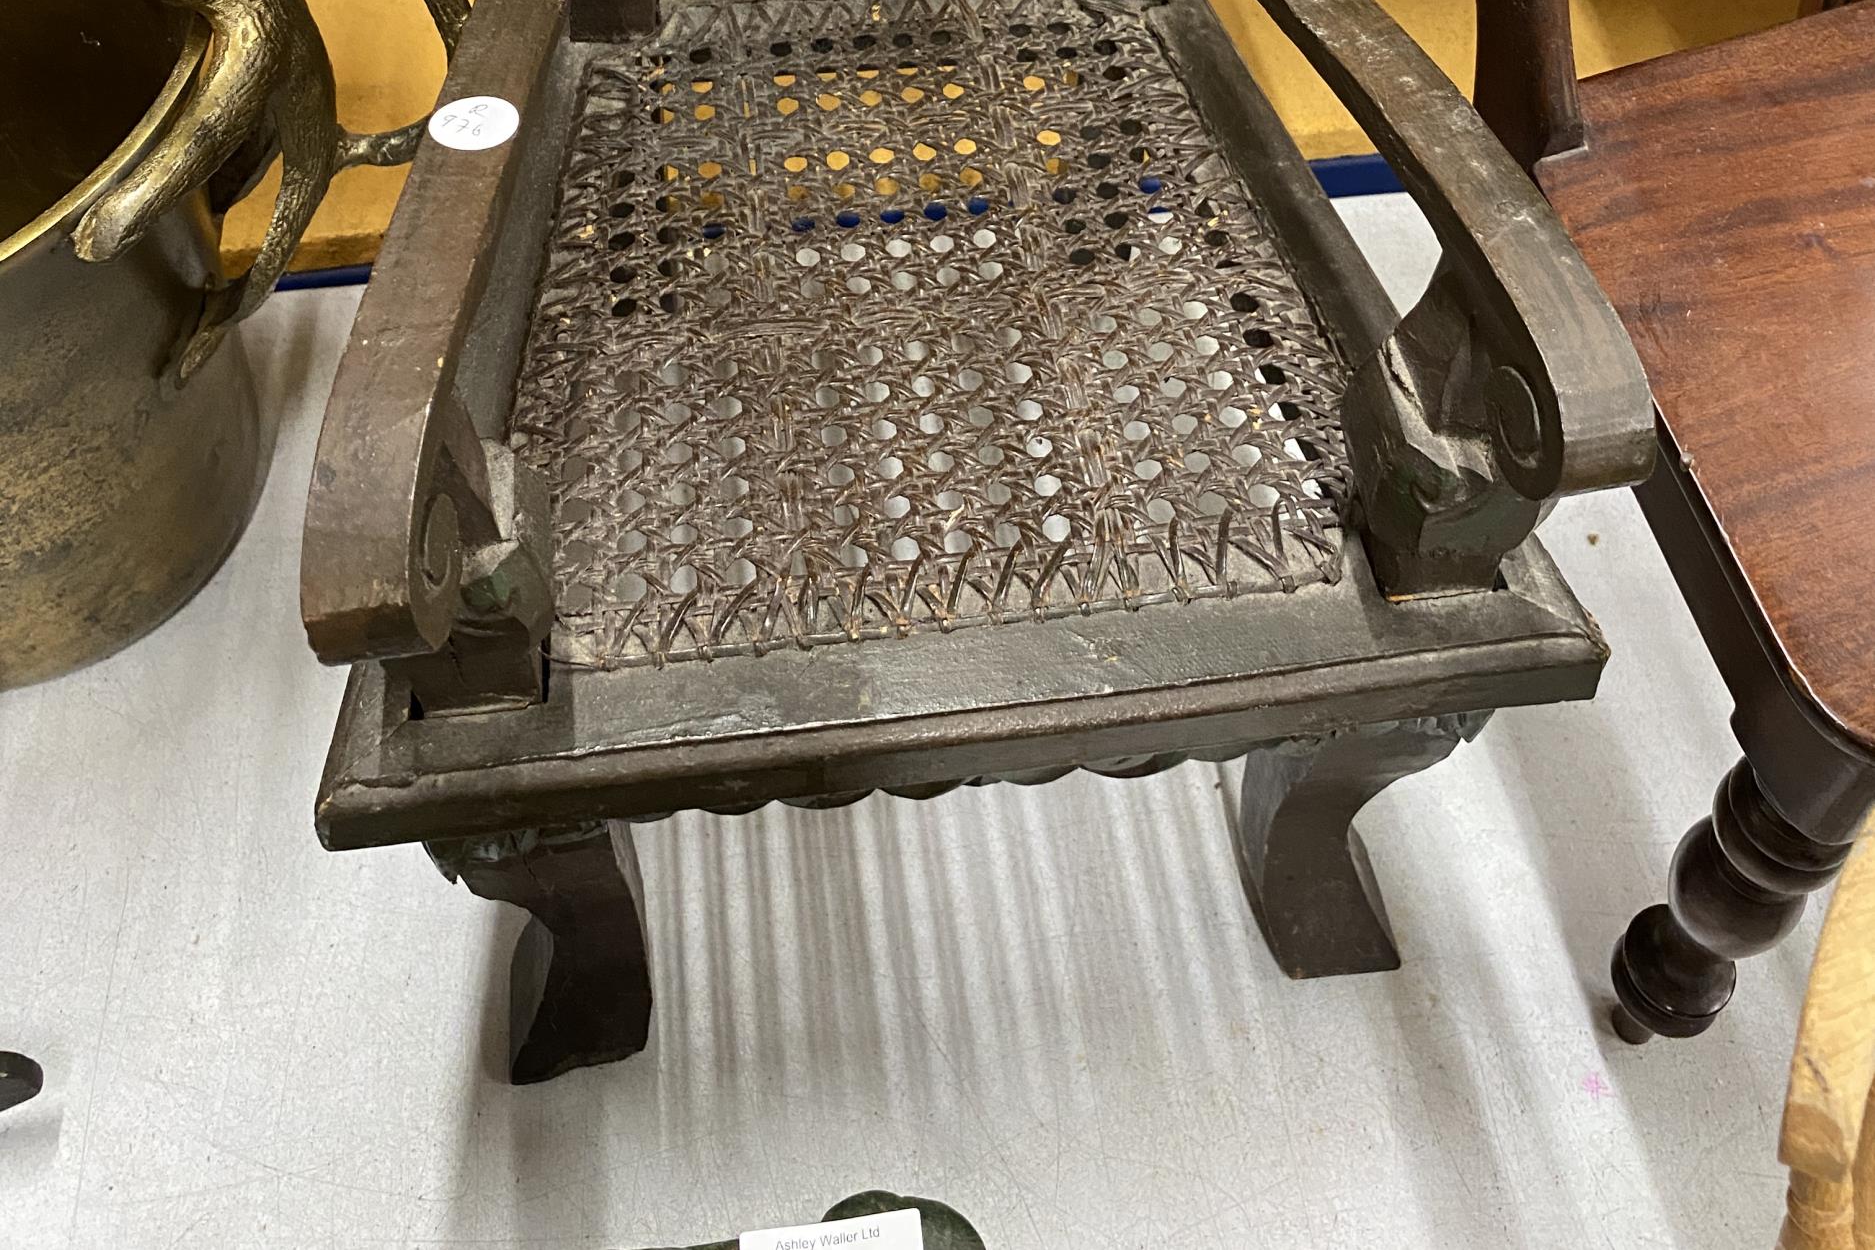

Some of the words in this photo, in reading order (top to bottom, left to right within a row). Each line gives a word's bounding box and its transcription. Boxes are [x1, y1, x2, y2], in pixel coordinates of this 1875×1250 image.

[442, 114, 482, 137] 976
[775, 1237, 817, 1250] Ashley
[819, 1231, 859, 1247] Waller
[861, 1225, 881, 1240] Ltd
